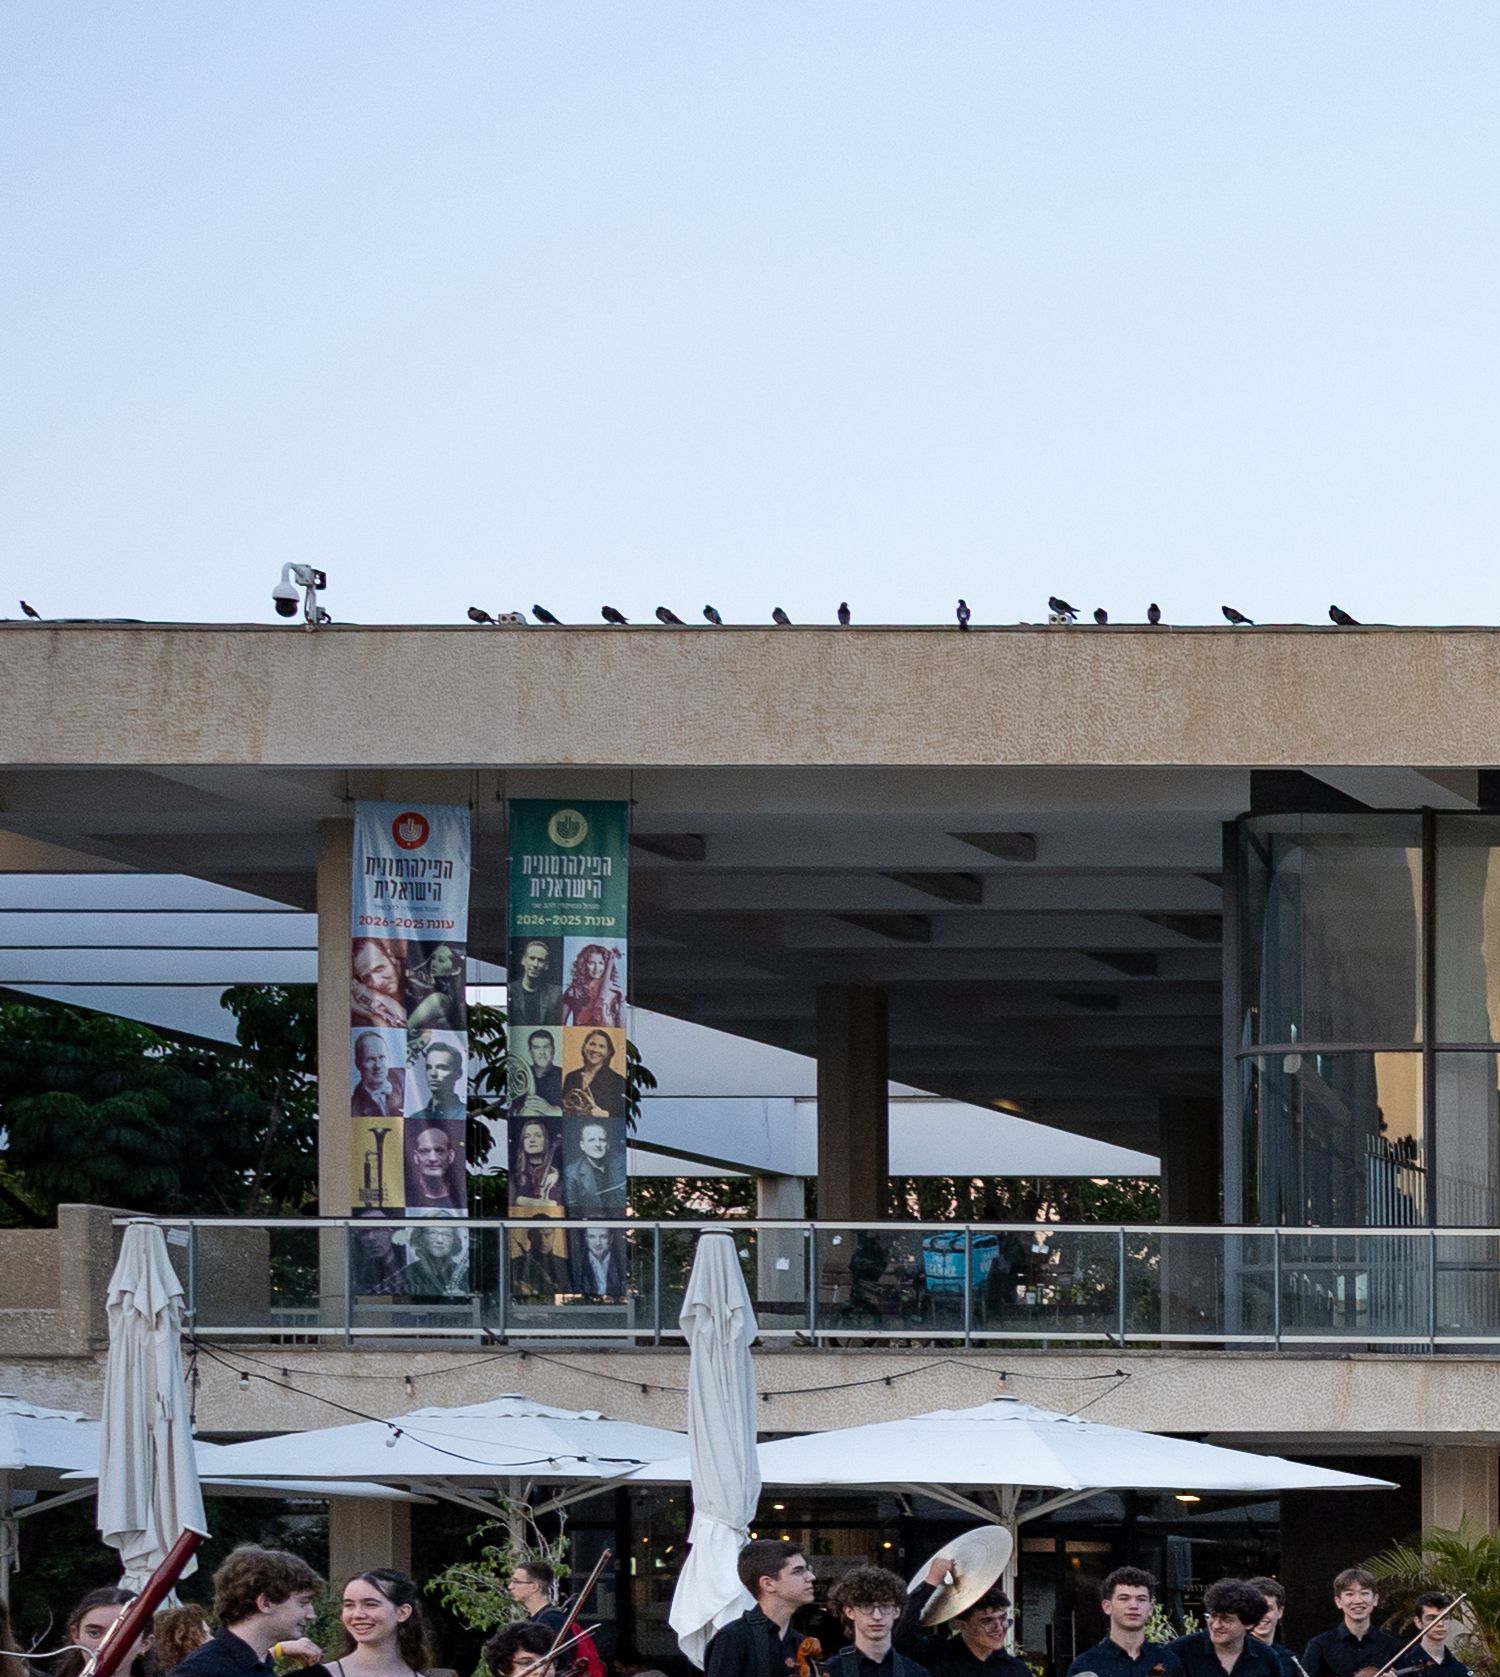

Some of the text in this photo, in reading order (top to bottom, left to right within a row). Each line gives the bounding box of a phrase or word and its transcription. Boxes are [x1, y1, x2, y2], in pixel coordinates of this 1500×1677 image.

[365, 856, 453, 879] הפילהרמונית
[522, 855, 612, 876] הפילהרמונית
[374, 879, 442, 901] הישראלית
[530, 877, 602, 899] הישראלית
[427, 919, 455, 929] עונת
[583, 916, 615, 927] עונת
